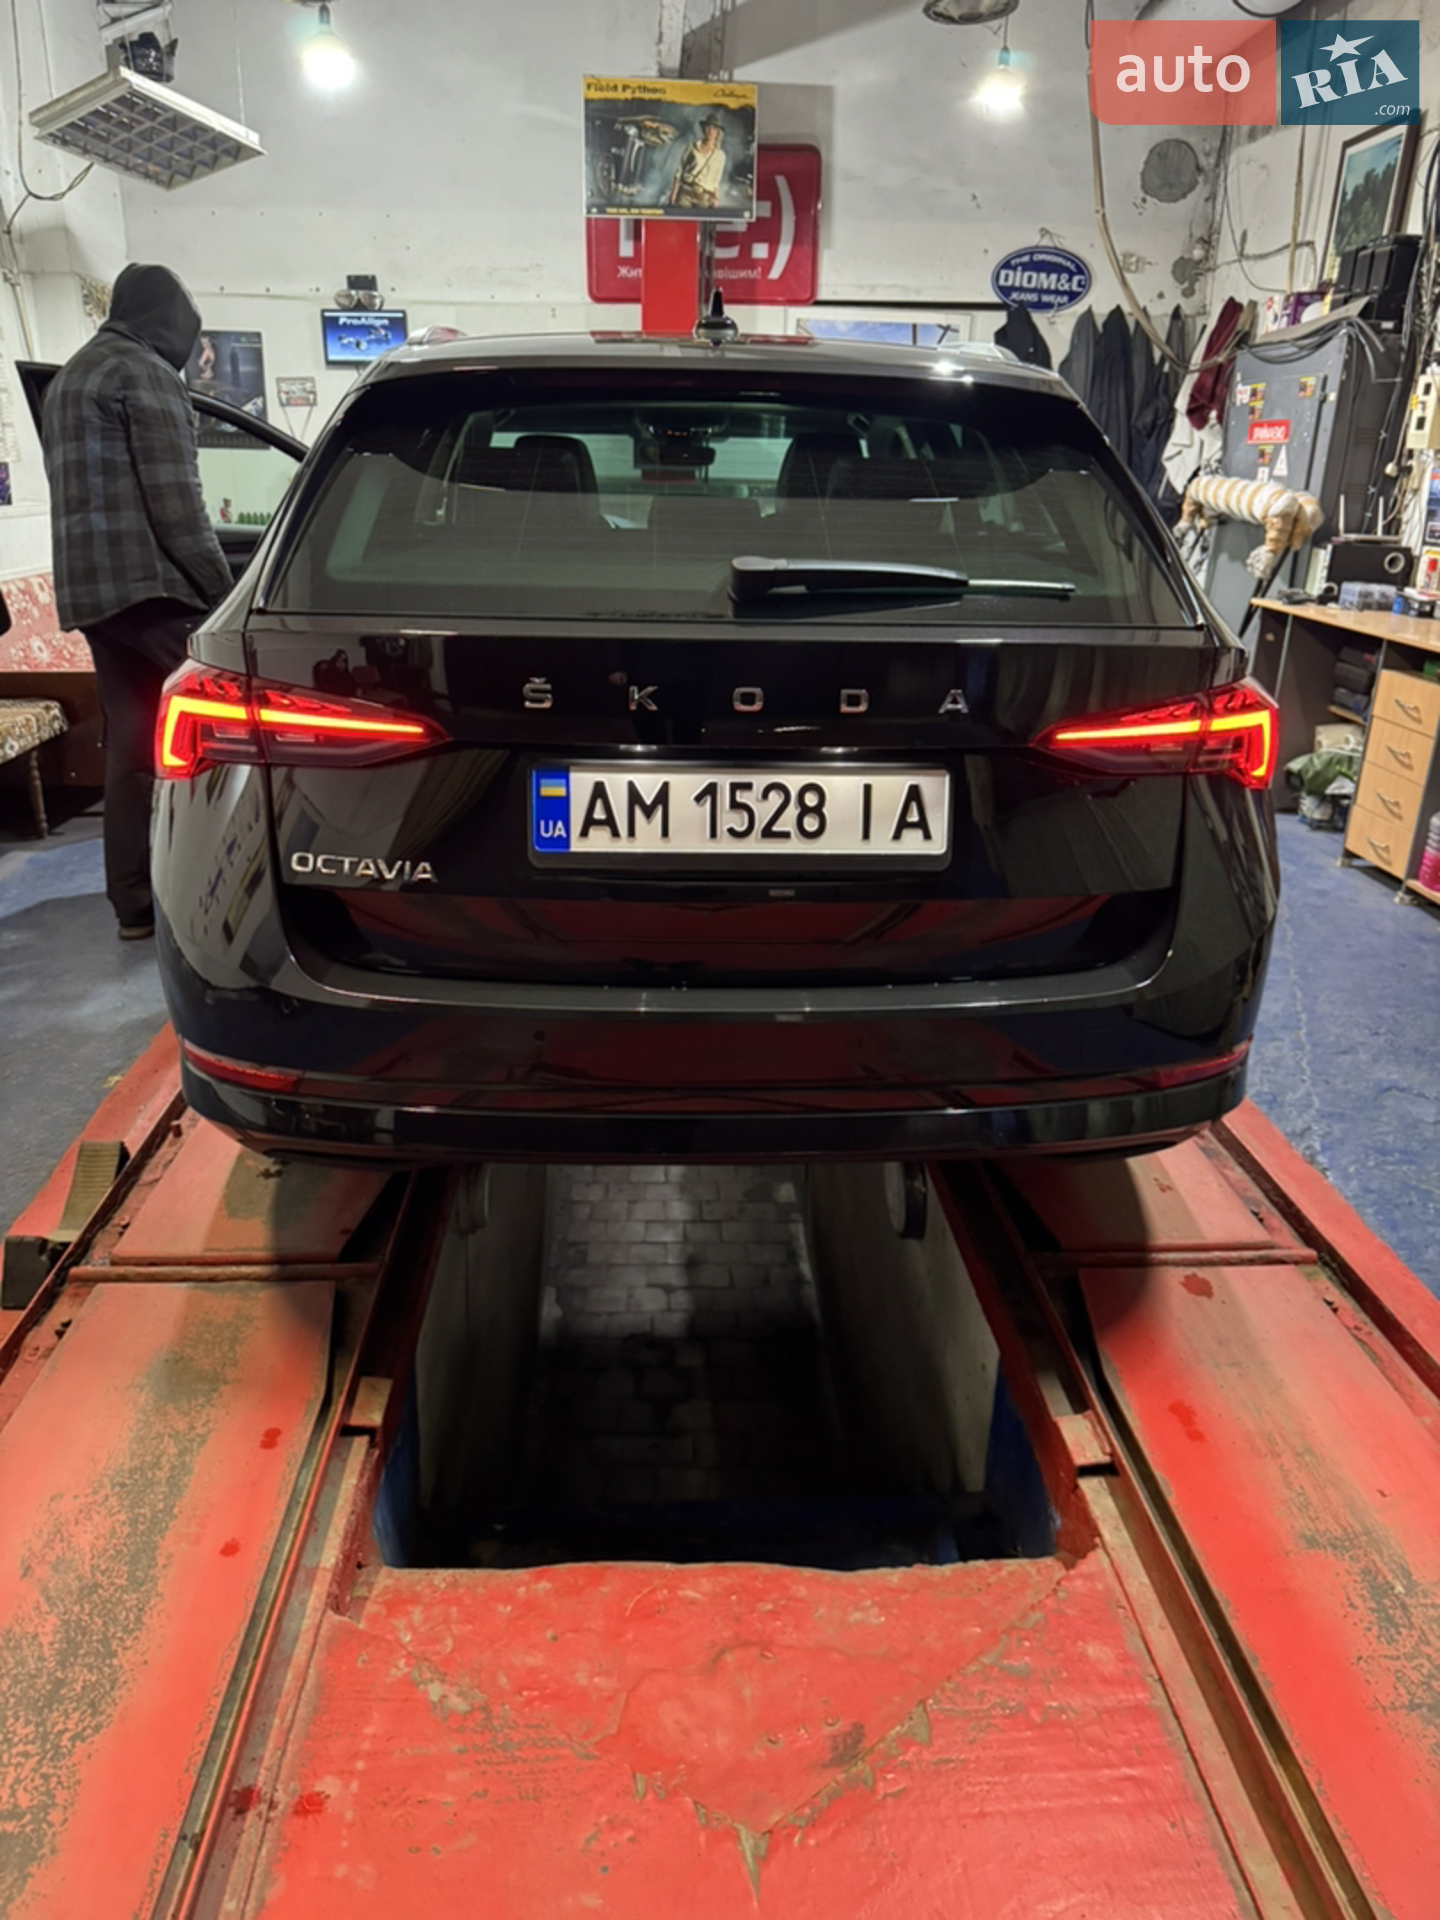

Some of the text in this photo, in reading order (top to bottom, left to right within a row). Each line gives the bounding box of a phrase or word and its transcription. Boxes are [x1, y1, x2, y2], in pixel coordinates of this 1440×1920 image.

[586, 82, 667, 95] Field Python
[1009, 291, 1069, 304] JEANS WEAR
[523, 677, 969, 714] ŠKODA
[540, 780, 932, 840] UA AM 1528 IA
[291, 851, 438, 883] OCTAVIA
